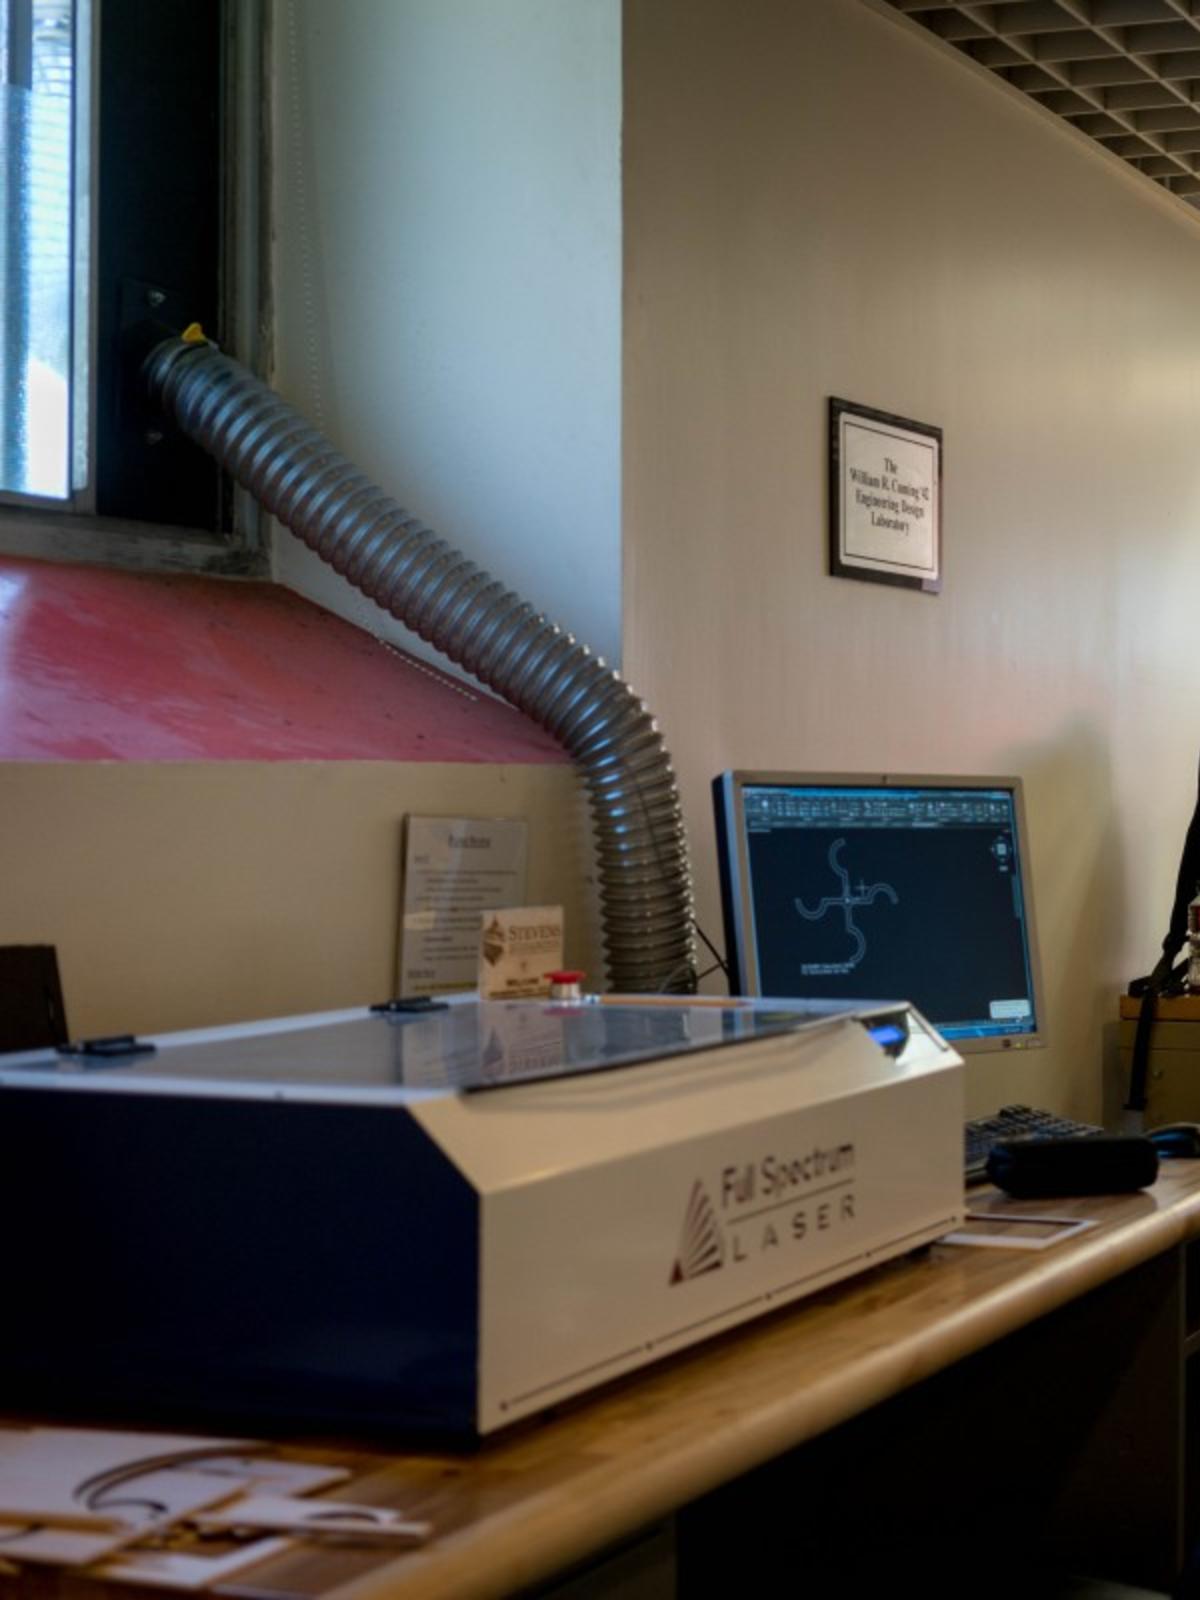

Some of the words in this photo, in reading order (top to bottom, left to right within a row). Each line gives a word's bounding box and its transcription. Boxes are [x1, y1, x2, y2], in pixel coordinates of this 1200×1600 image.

[849, 467, 880, 489] William
[883, 456, 898, 475] The
[855, 489, 899, 513] Engineering
[901, 499, 925, 520] Design
[871, 511, 909, 536] Laboratory
[721, 1161, 755, 1211] Full
[761, 1143, 854, 1197] Spectrum
[732, 1193, 855, 1263] LASER
